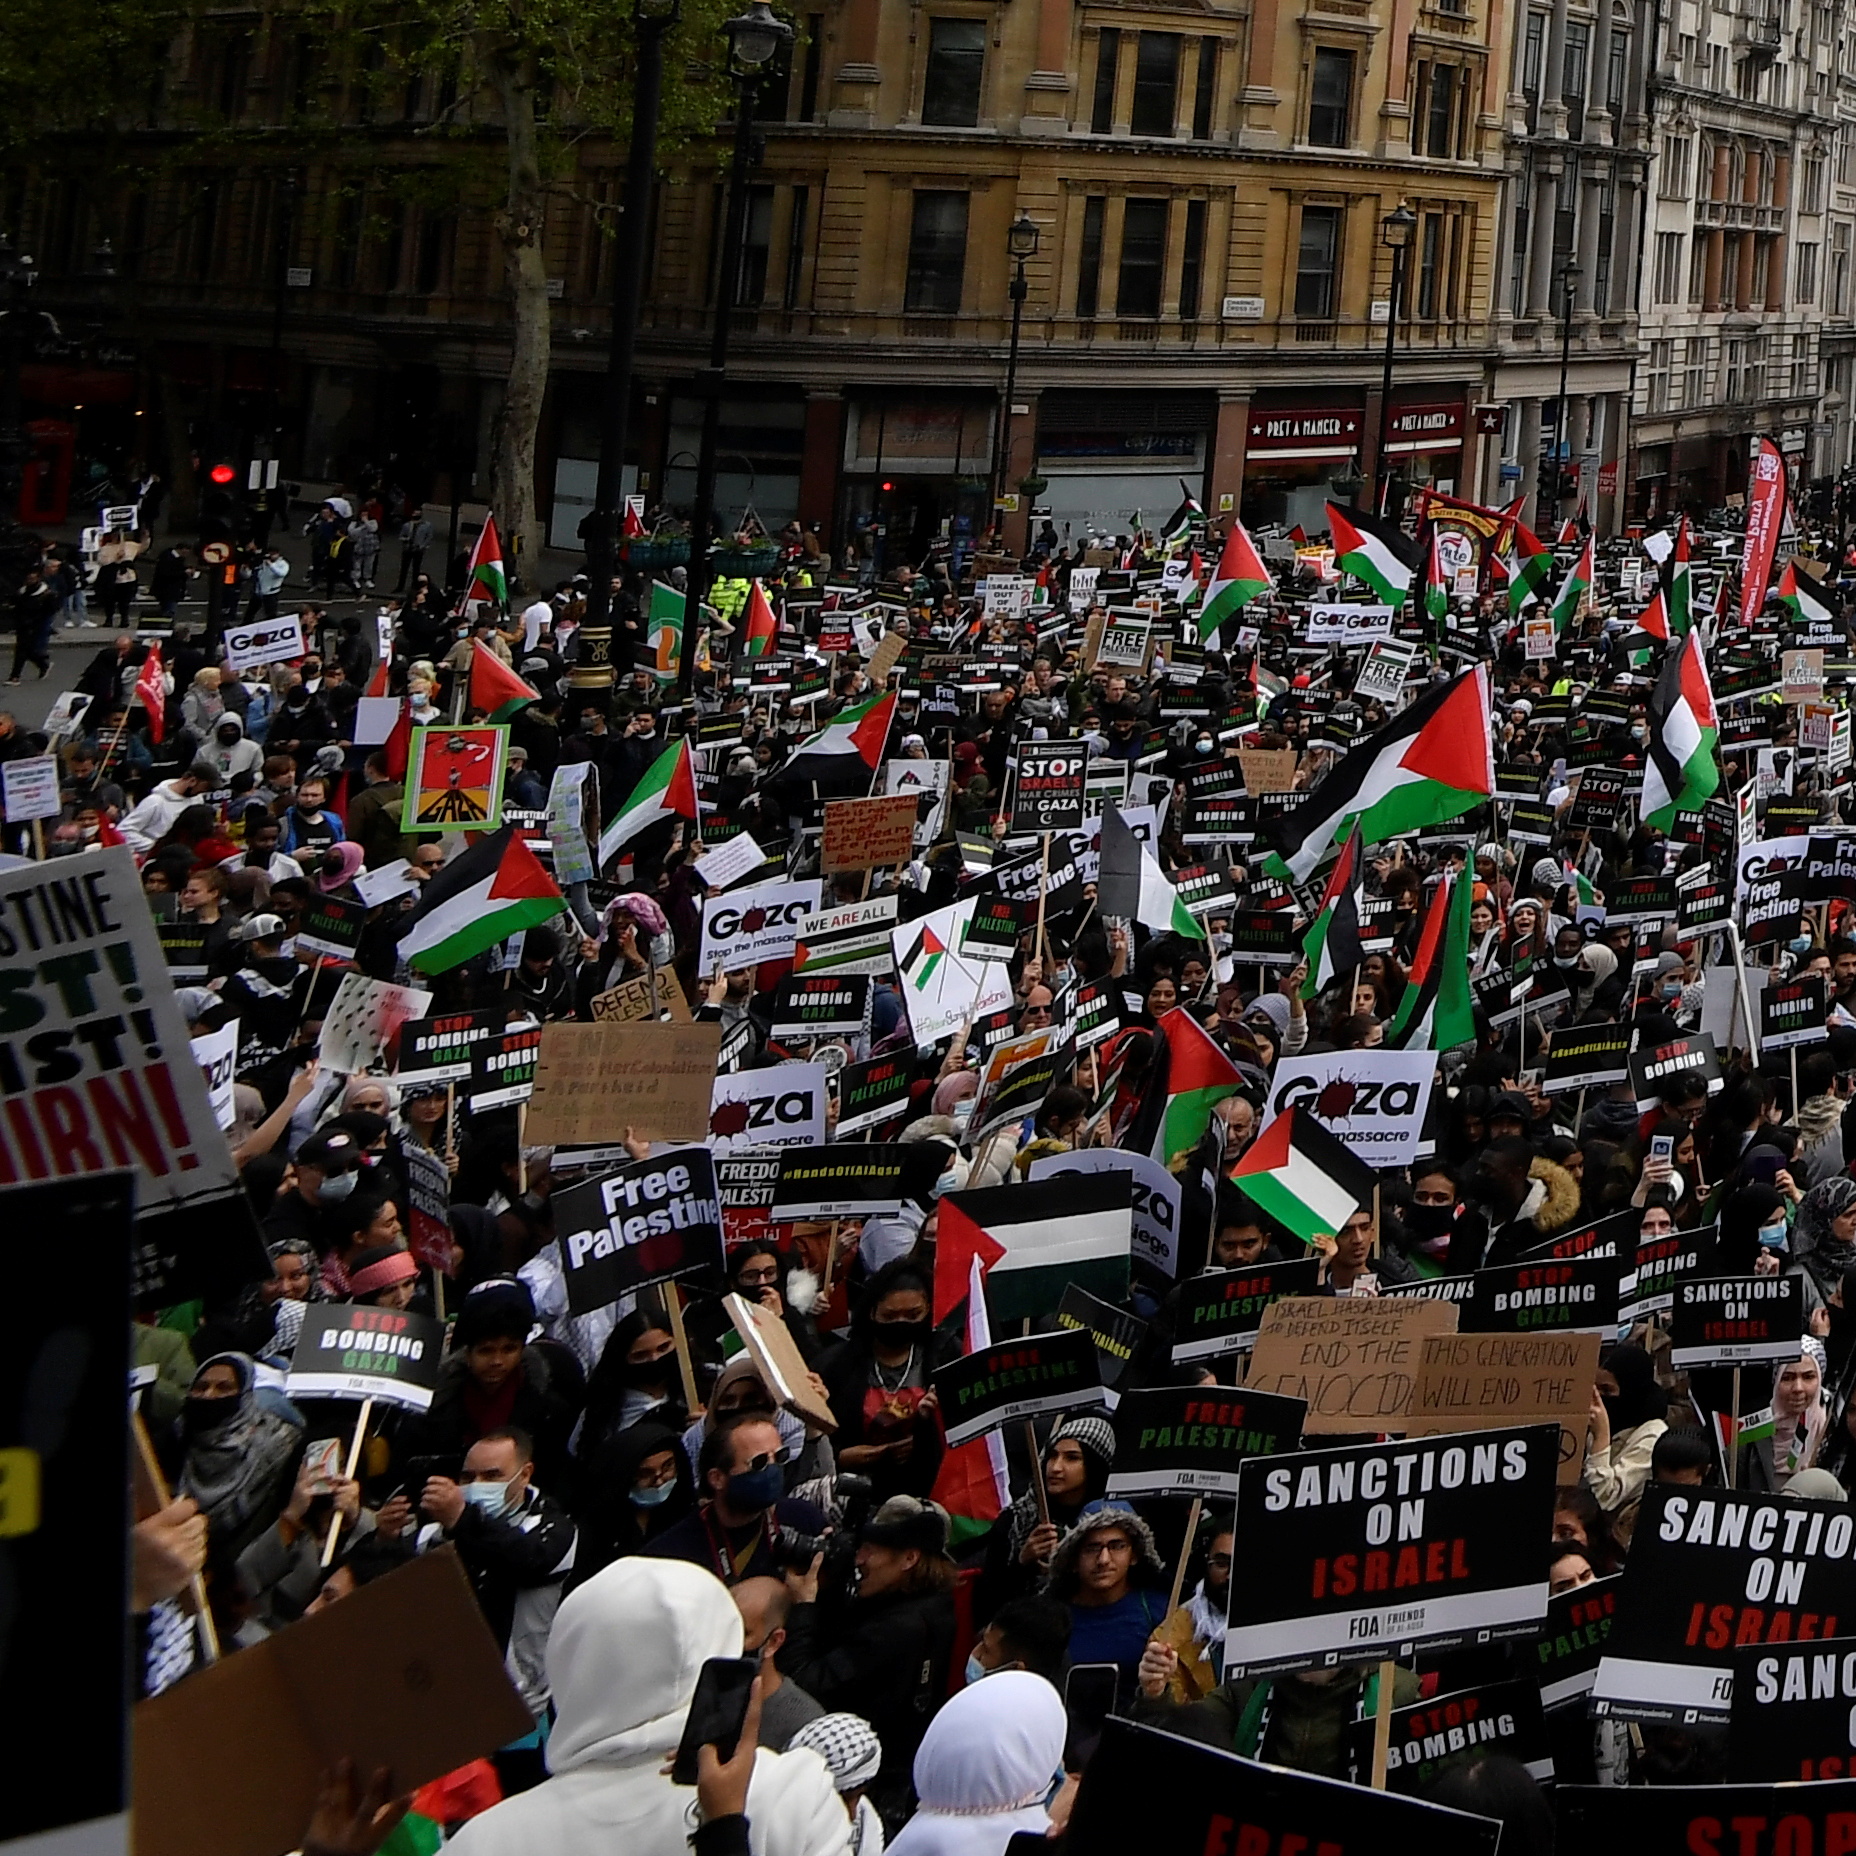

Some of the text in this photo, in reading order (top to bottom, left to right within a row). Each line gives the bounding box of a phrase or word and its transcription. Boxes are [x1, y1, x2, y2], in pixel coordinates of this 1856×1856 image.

[1266, 418, 1341, 438] PRET A MANGER
[1104, 631, 1147, 647] FREE
[1021, 759, 1083, 777] STOP
[1018, 776, 1082, 791] ISRAEL'S
[1019, 790, 1041, 799] WAR
[1018, 798, 1079, 812] IN GAZA
[805, 906, 888, 932] WE ARE ALL
[592, 973, 667, 1017] DEFEND
[601, 1164, 691, 1216] Free
[566, 1193, 719, 1271] Palestine
[351, 1311, 409, 1334] STOP
[1274, 1300, 1326, 1320] ISRAEL
[1284, 1321, 1340, 1337] DEFEND
[321, 1329, 425, 1362] BOMBING
[1300, 1340, 1411, 1367] END THE
[1424, 1338, 1579, 1368] THIS GENERATION
[342, 1350, 399, 1374] GAZA
[1423, 1376, 1576, 1408] WILL END THE
[1265, 1440, 1528, 1513] SANCTIONS
[1366, 1498, 1425, 1546] ON
[1311, 1538, 1470, 1600] ISRAEL
[1744, 1557, 1807, 1606] ON
[1349, 1615, 1380, 1639] FOA
